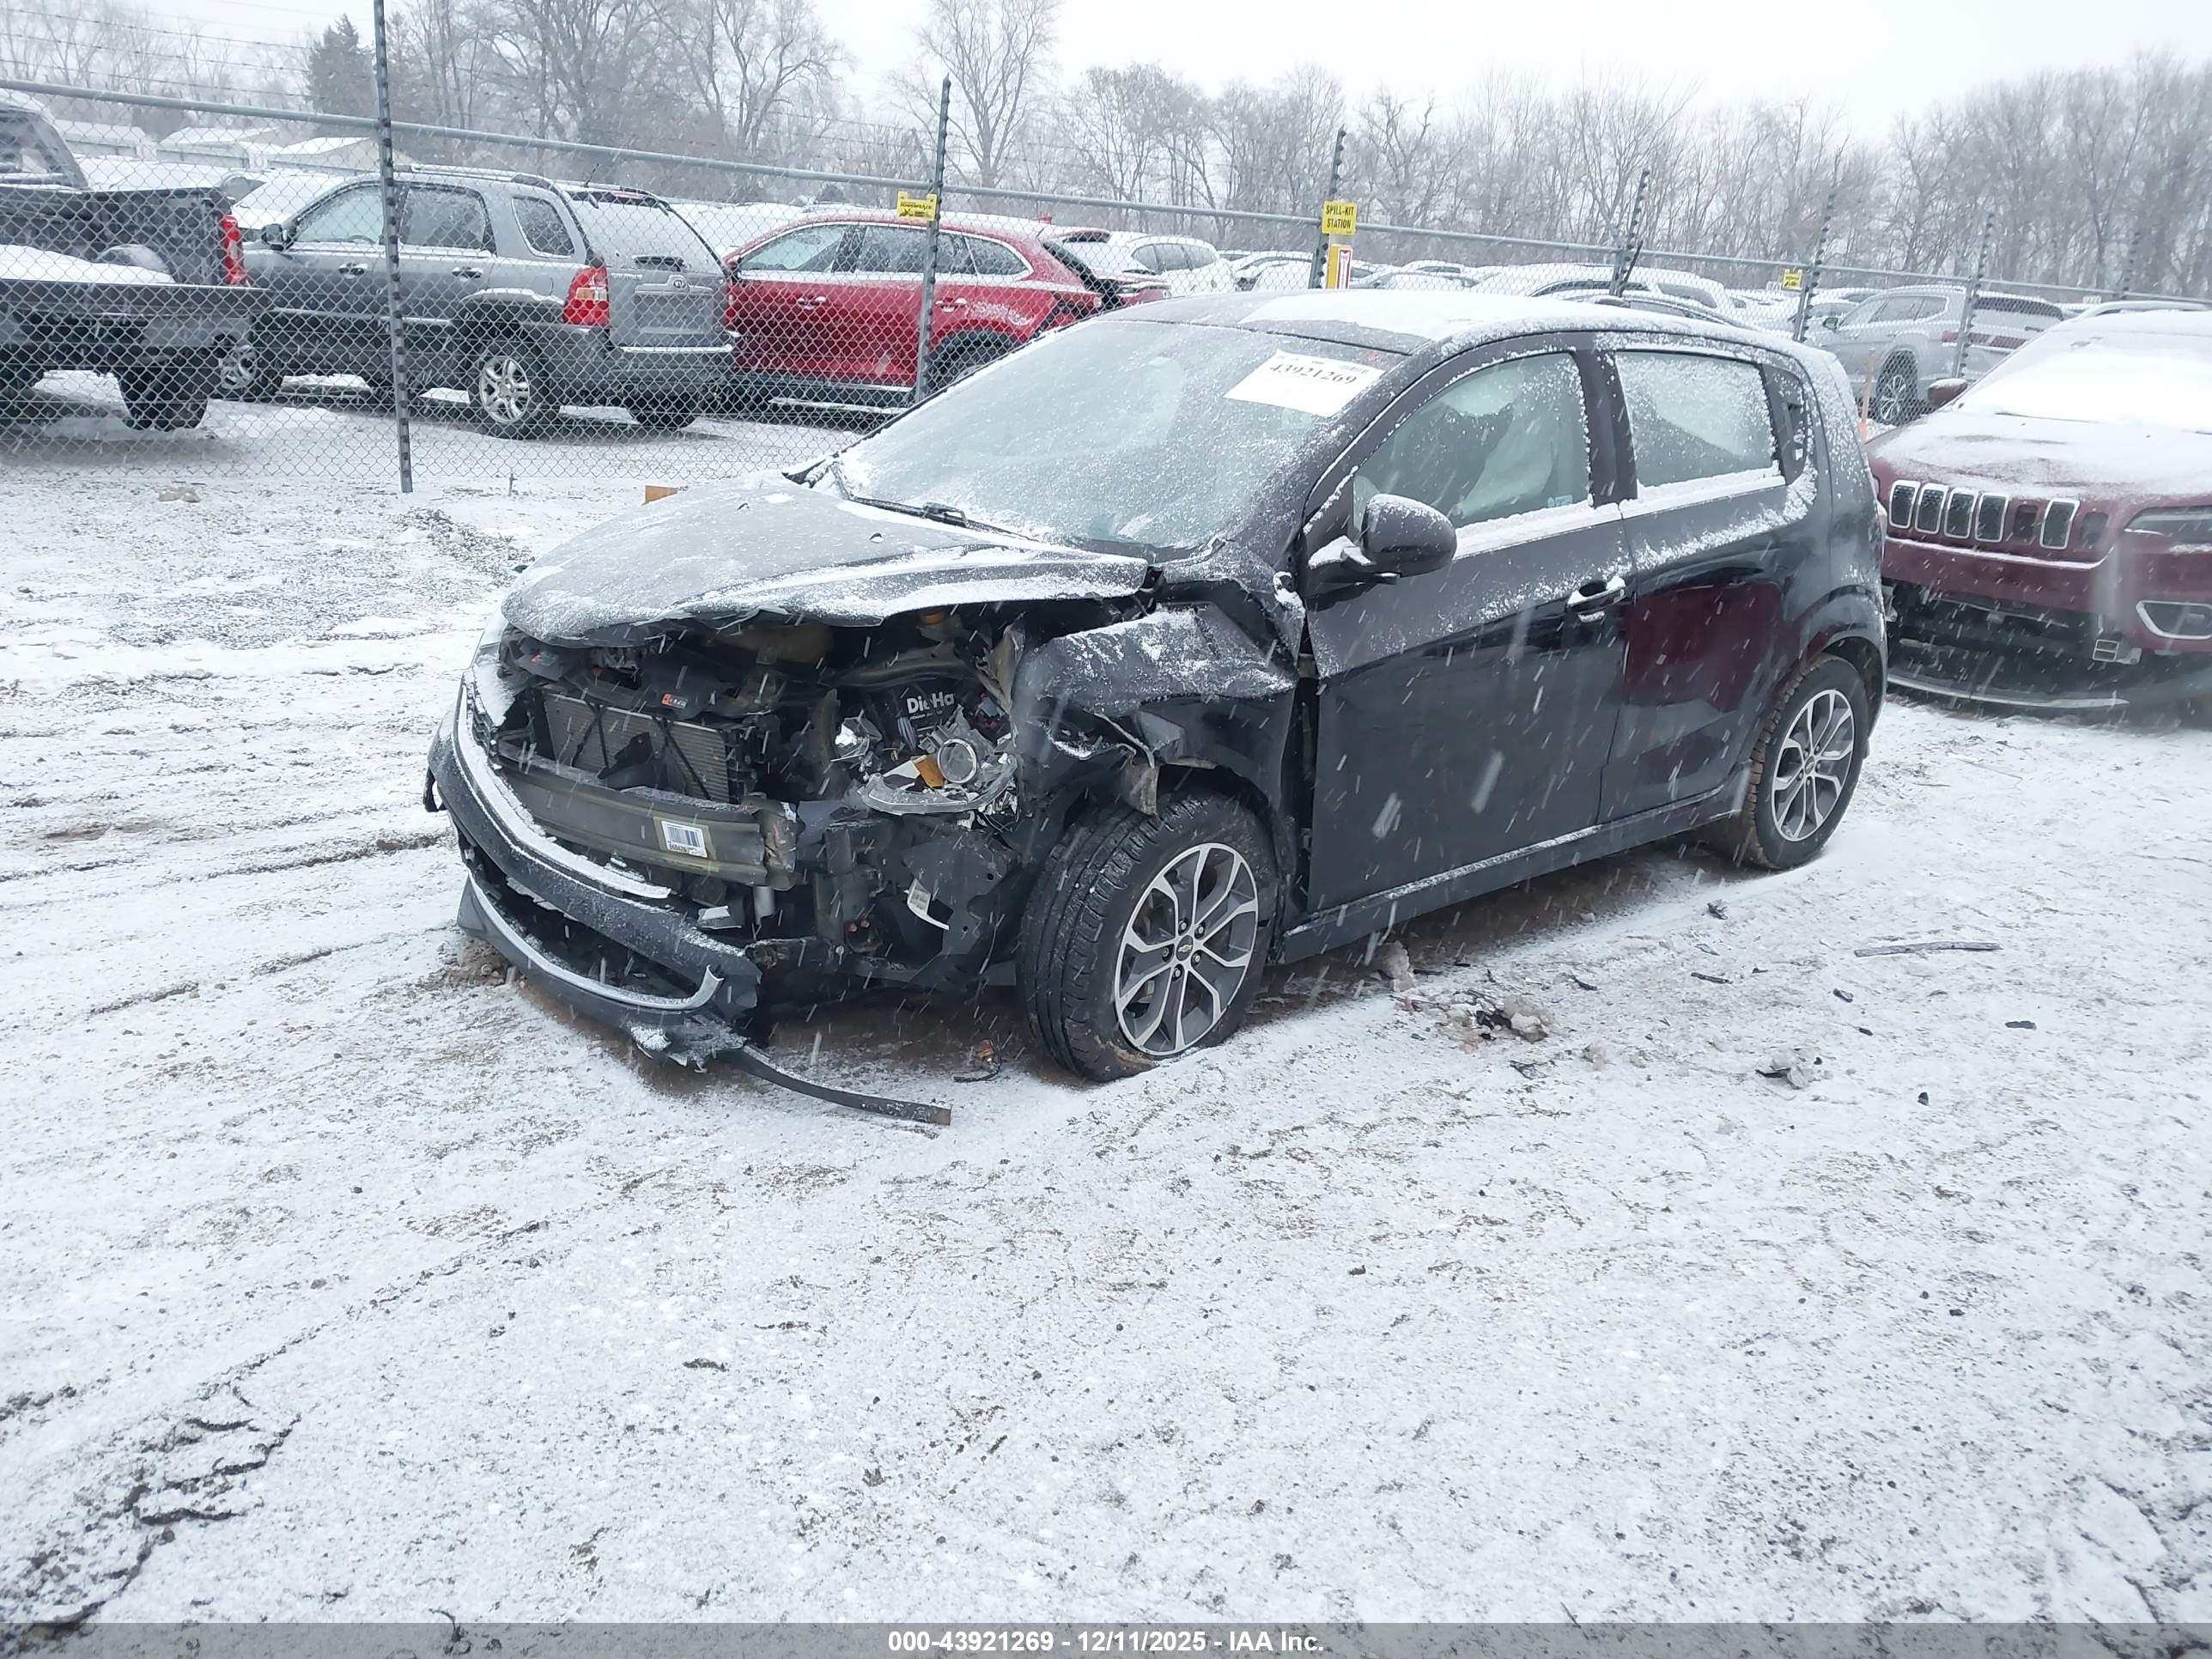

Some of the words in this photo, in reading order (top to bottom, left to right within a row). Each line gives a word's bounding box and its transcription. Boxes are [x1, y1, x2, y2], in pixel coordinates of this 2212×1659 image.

[1325, 204, 1354, 216] SPILL-KIT
[1327, 218, 1352, 229] STATION
[1270, 363, 1358, 385] 43921269
